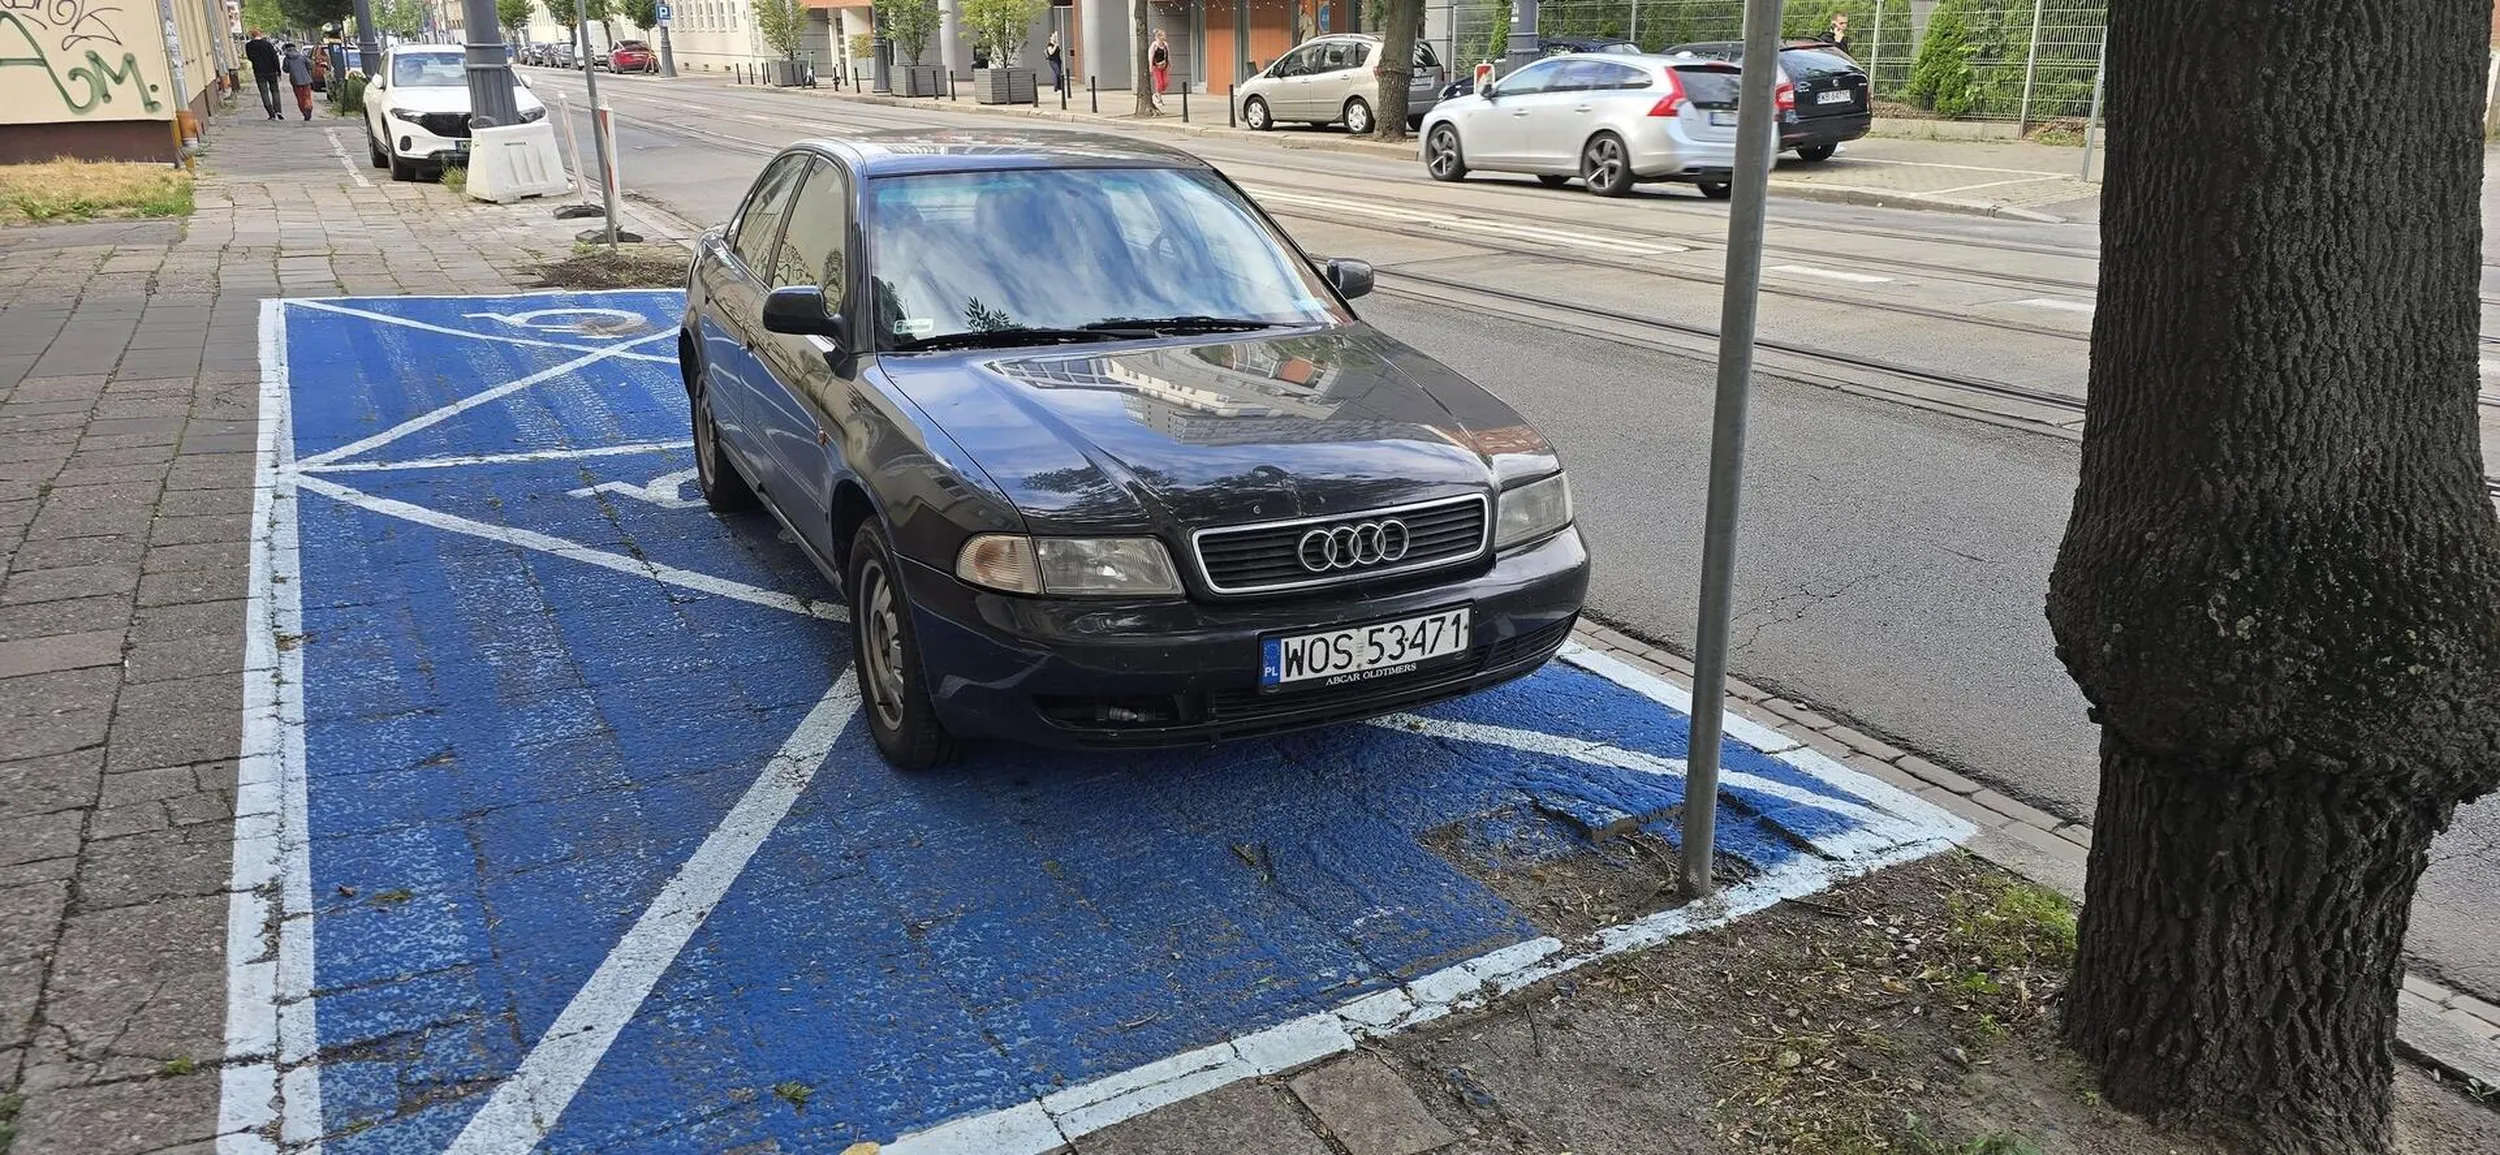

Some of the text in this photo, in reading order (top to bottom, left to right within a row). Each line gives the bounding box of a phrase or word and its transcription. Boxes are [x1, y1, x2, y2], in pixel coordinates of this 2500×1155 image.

[1284, 613, 1461, 678] WOS 53471
[1264, 666, 1279, 678] PL
[1325, 662, 1417, 686] ABCAR OLDTIMERS
